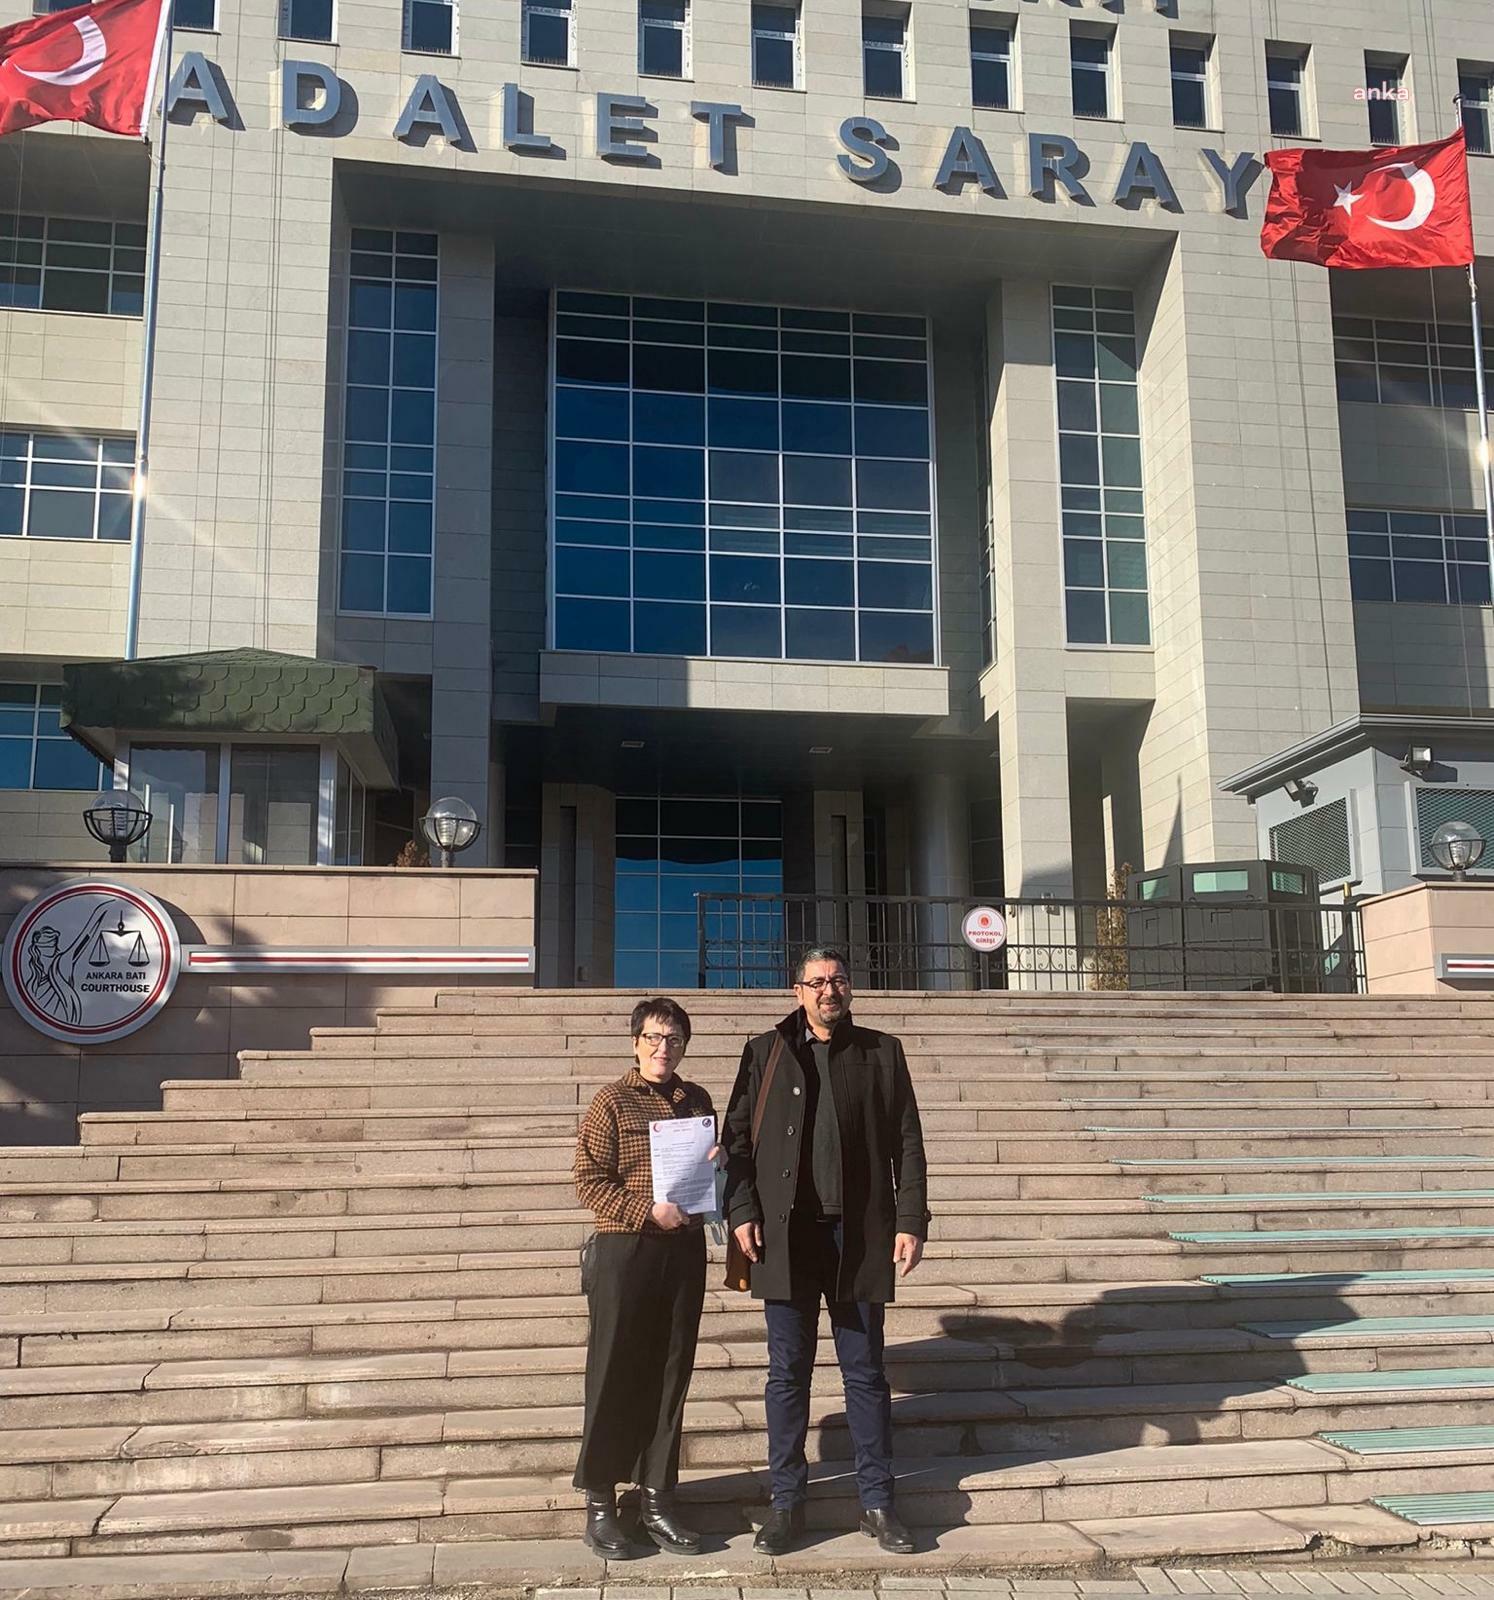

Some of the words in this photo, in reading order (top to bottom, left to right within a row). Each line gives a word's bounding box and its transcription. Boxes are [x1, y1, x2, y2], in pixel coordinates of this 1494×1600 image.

[165, 51, 745, 169] ADALET
[86, 971, 123, 980] ANKARA
[126, 971, 146, 980] BATI
[81, 983, 150, 993] COURTHOUSE
